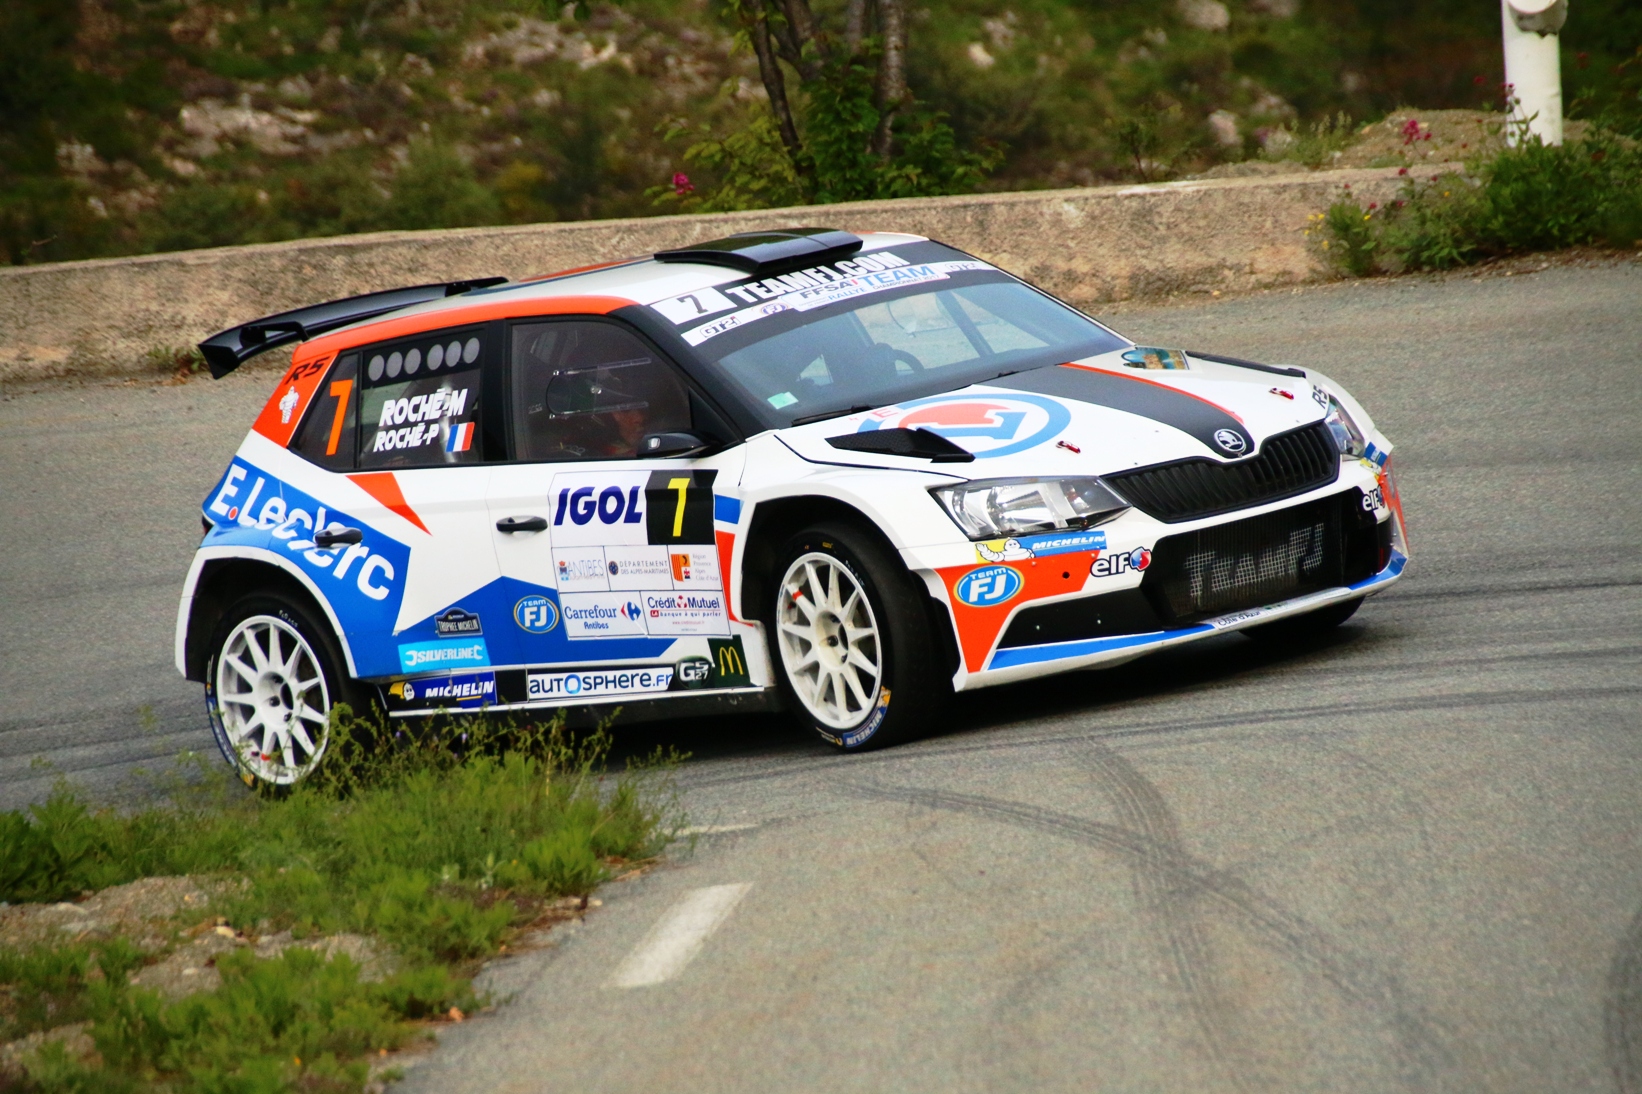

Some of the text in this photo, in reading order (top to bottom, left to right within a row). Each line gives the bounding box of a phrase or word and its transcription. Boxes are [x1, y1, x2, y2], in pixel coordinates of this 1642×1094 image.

[725, 252, 911, 303] TEAMFJ.COM
[800, 265, 935, 299] FFSA TEAM
[828, 287, 867, 301] RALLYE
[676, 294, 708, 314] 7
[326, 379, 354, 456] 7
[553, 477, 691, 538] IGOL 7
[1031, 535, 1106, 550] MICHELIN
[567, 560, 604, 577] ANTIBES
[619, 559, 668, 569] DÉPARTEMENT
[970, 567, 1007, 579] TEAM
[1090, 553, 1132, 578] elf
[969, 574, 1008, 603] FJ
[523, 599, 547, 607] TEAM
[564, 601, 617, 620] Carrefour
[647, 596, 720, 609] Crédit Mutuel
[458, 619, 479, 631] MICHELIN
[523, 605, 548, 628] FJ
[583, 621, 609, 630] Antibes
[425, 680, 494, 699] MICHELIN
